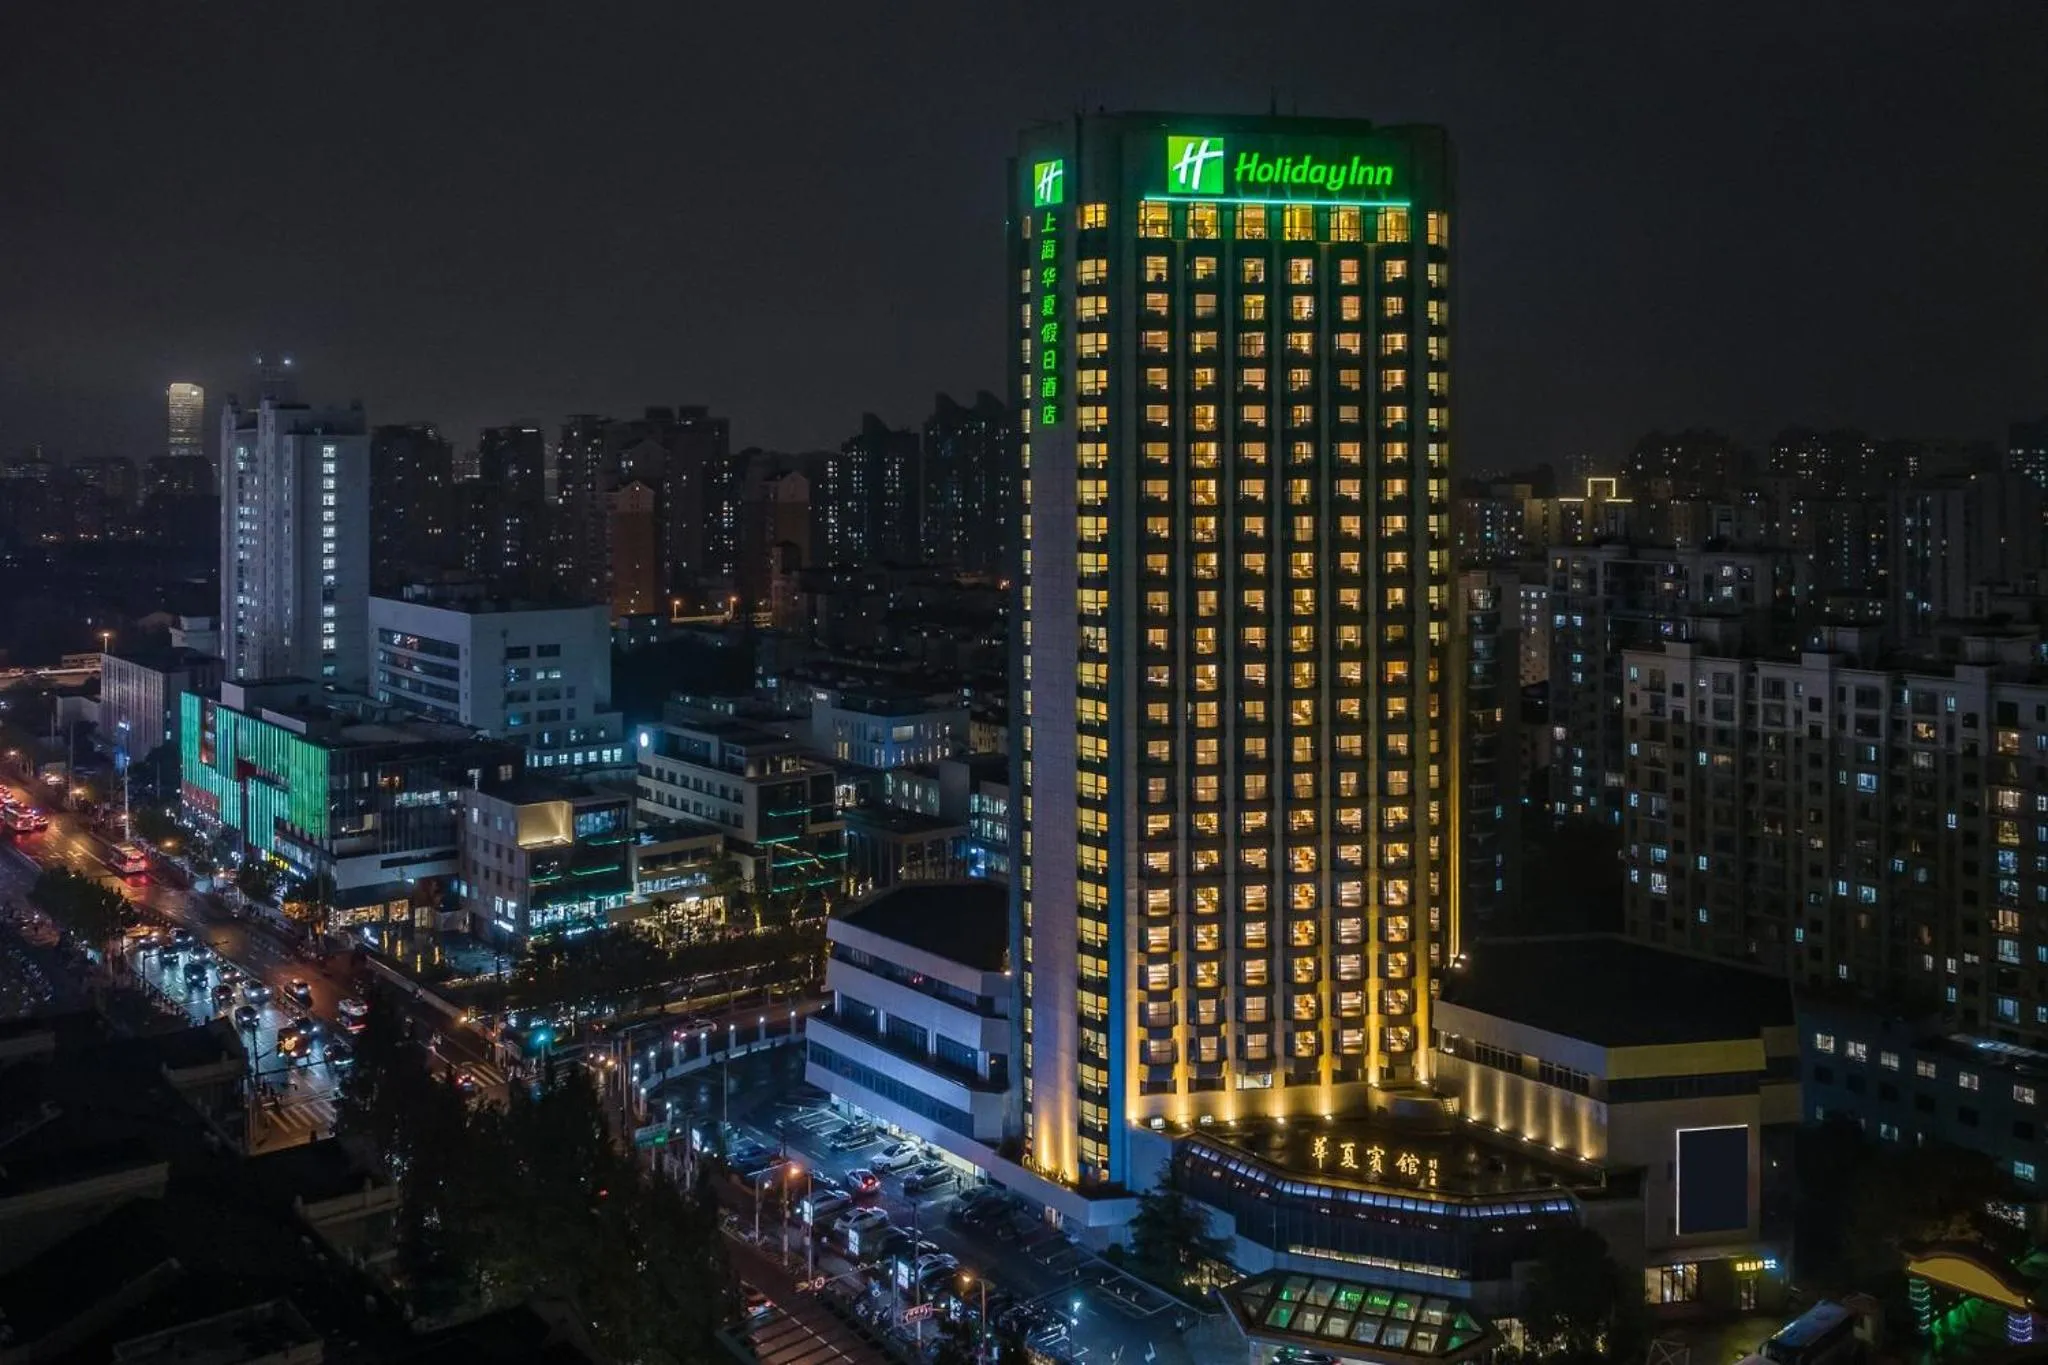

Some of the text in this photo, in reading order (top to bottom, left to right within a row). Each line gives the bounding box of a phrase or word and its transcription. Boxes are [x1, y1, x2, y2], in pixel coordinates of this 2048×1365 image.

[1234, 152, 1394, 191] Holiday Inn
[1041, 212, 1058, 425] 上海华夏假日酒店
[1311, 1136, 1421, 1176] 華夏賓館
